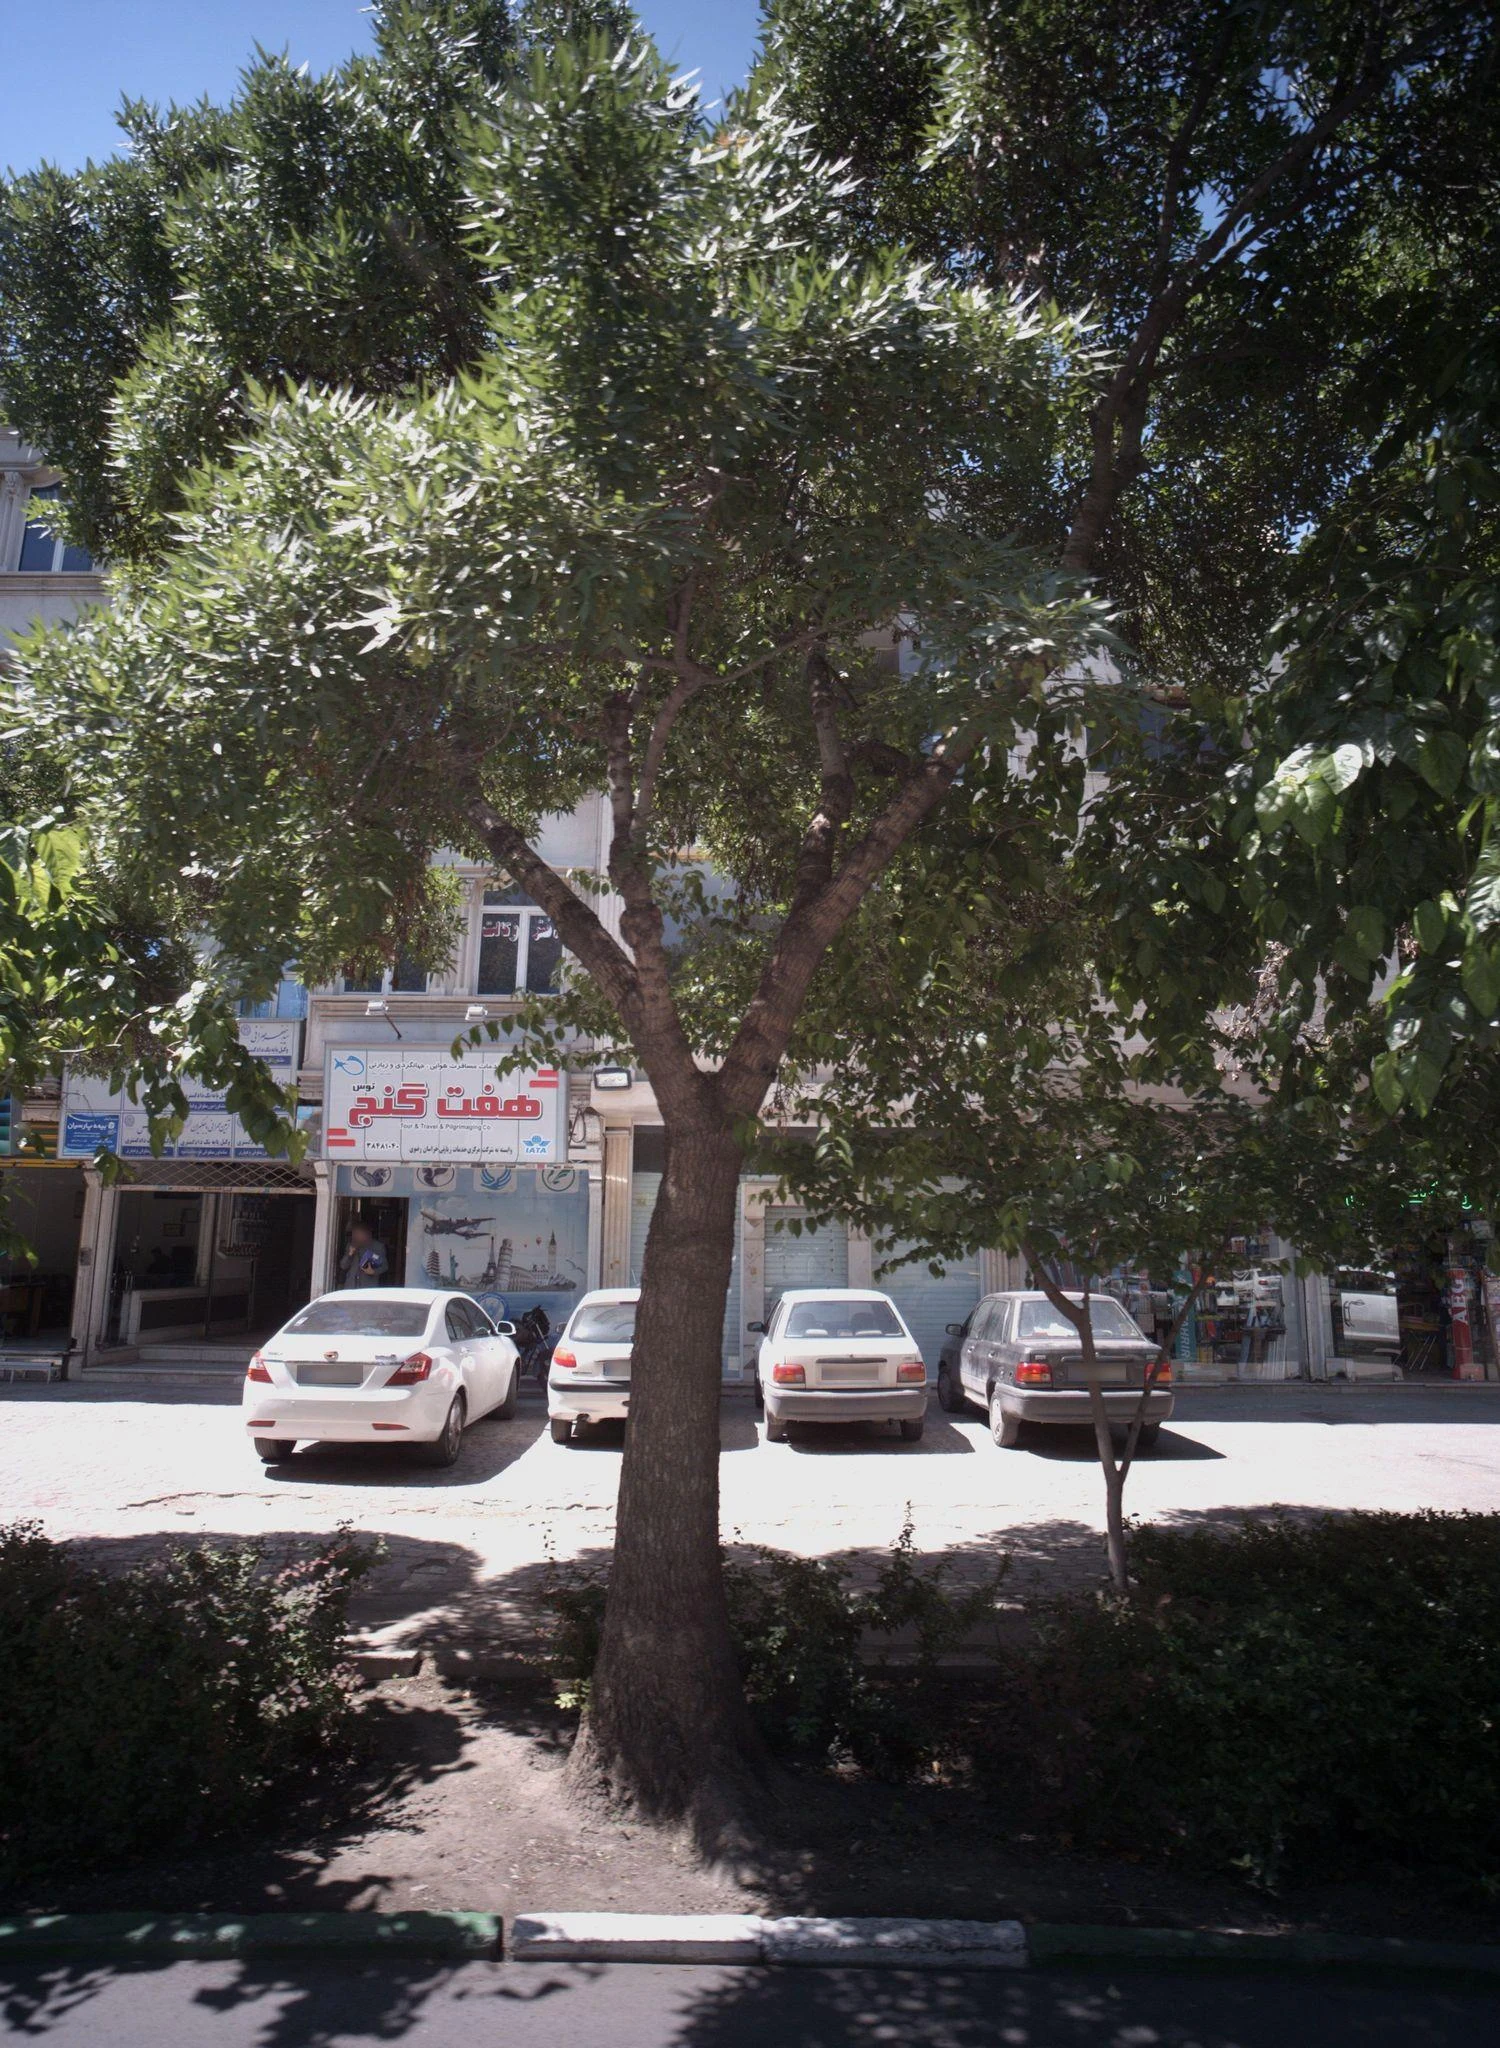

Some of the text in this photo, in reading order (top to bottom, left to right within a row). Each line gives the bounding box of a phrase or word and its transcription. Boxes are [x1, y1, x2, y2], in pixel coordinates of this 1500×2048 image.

[482, 921, 520, 942] وکالت
[369, 1061, 389, 1071] زیارتی
[395, 1061, 425, 1071] جهانگردی
[430, 1062, 448, 1071] هوایی
[450, 1062, 477, 1071] مسافرت
[348, 1081, 543, 1129] هفت گنج توس
[67, 1122, 107, 1131] بیمه پارسیان
[409, 1145, 422, 1154] رضوی
[423, 1145, 439, 1153] خراسان
[439, 1146, 452, 1154] زیارتی
[467, 1146, 481, 1154] مرکزی
[481, 1146, 494, 1154] شرکت
[500, 1146, 513, 1154] وابسته
[1451, 1279, 1468, 1325] AEG
[1180, 1315, 1191, 1358] AHRIR
